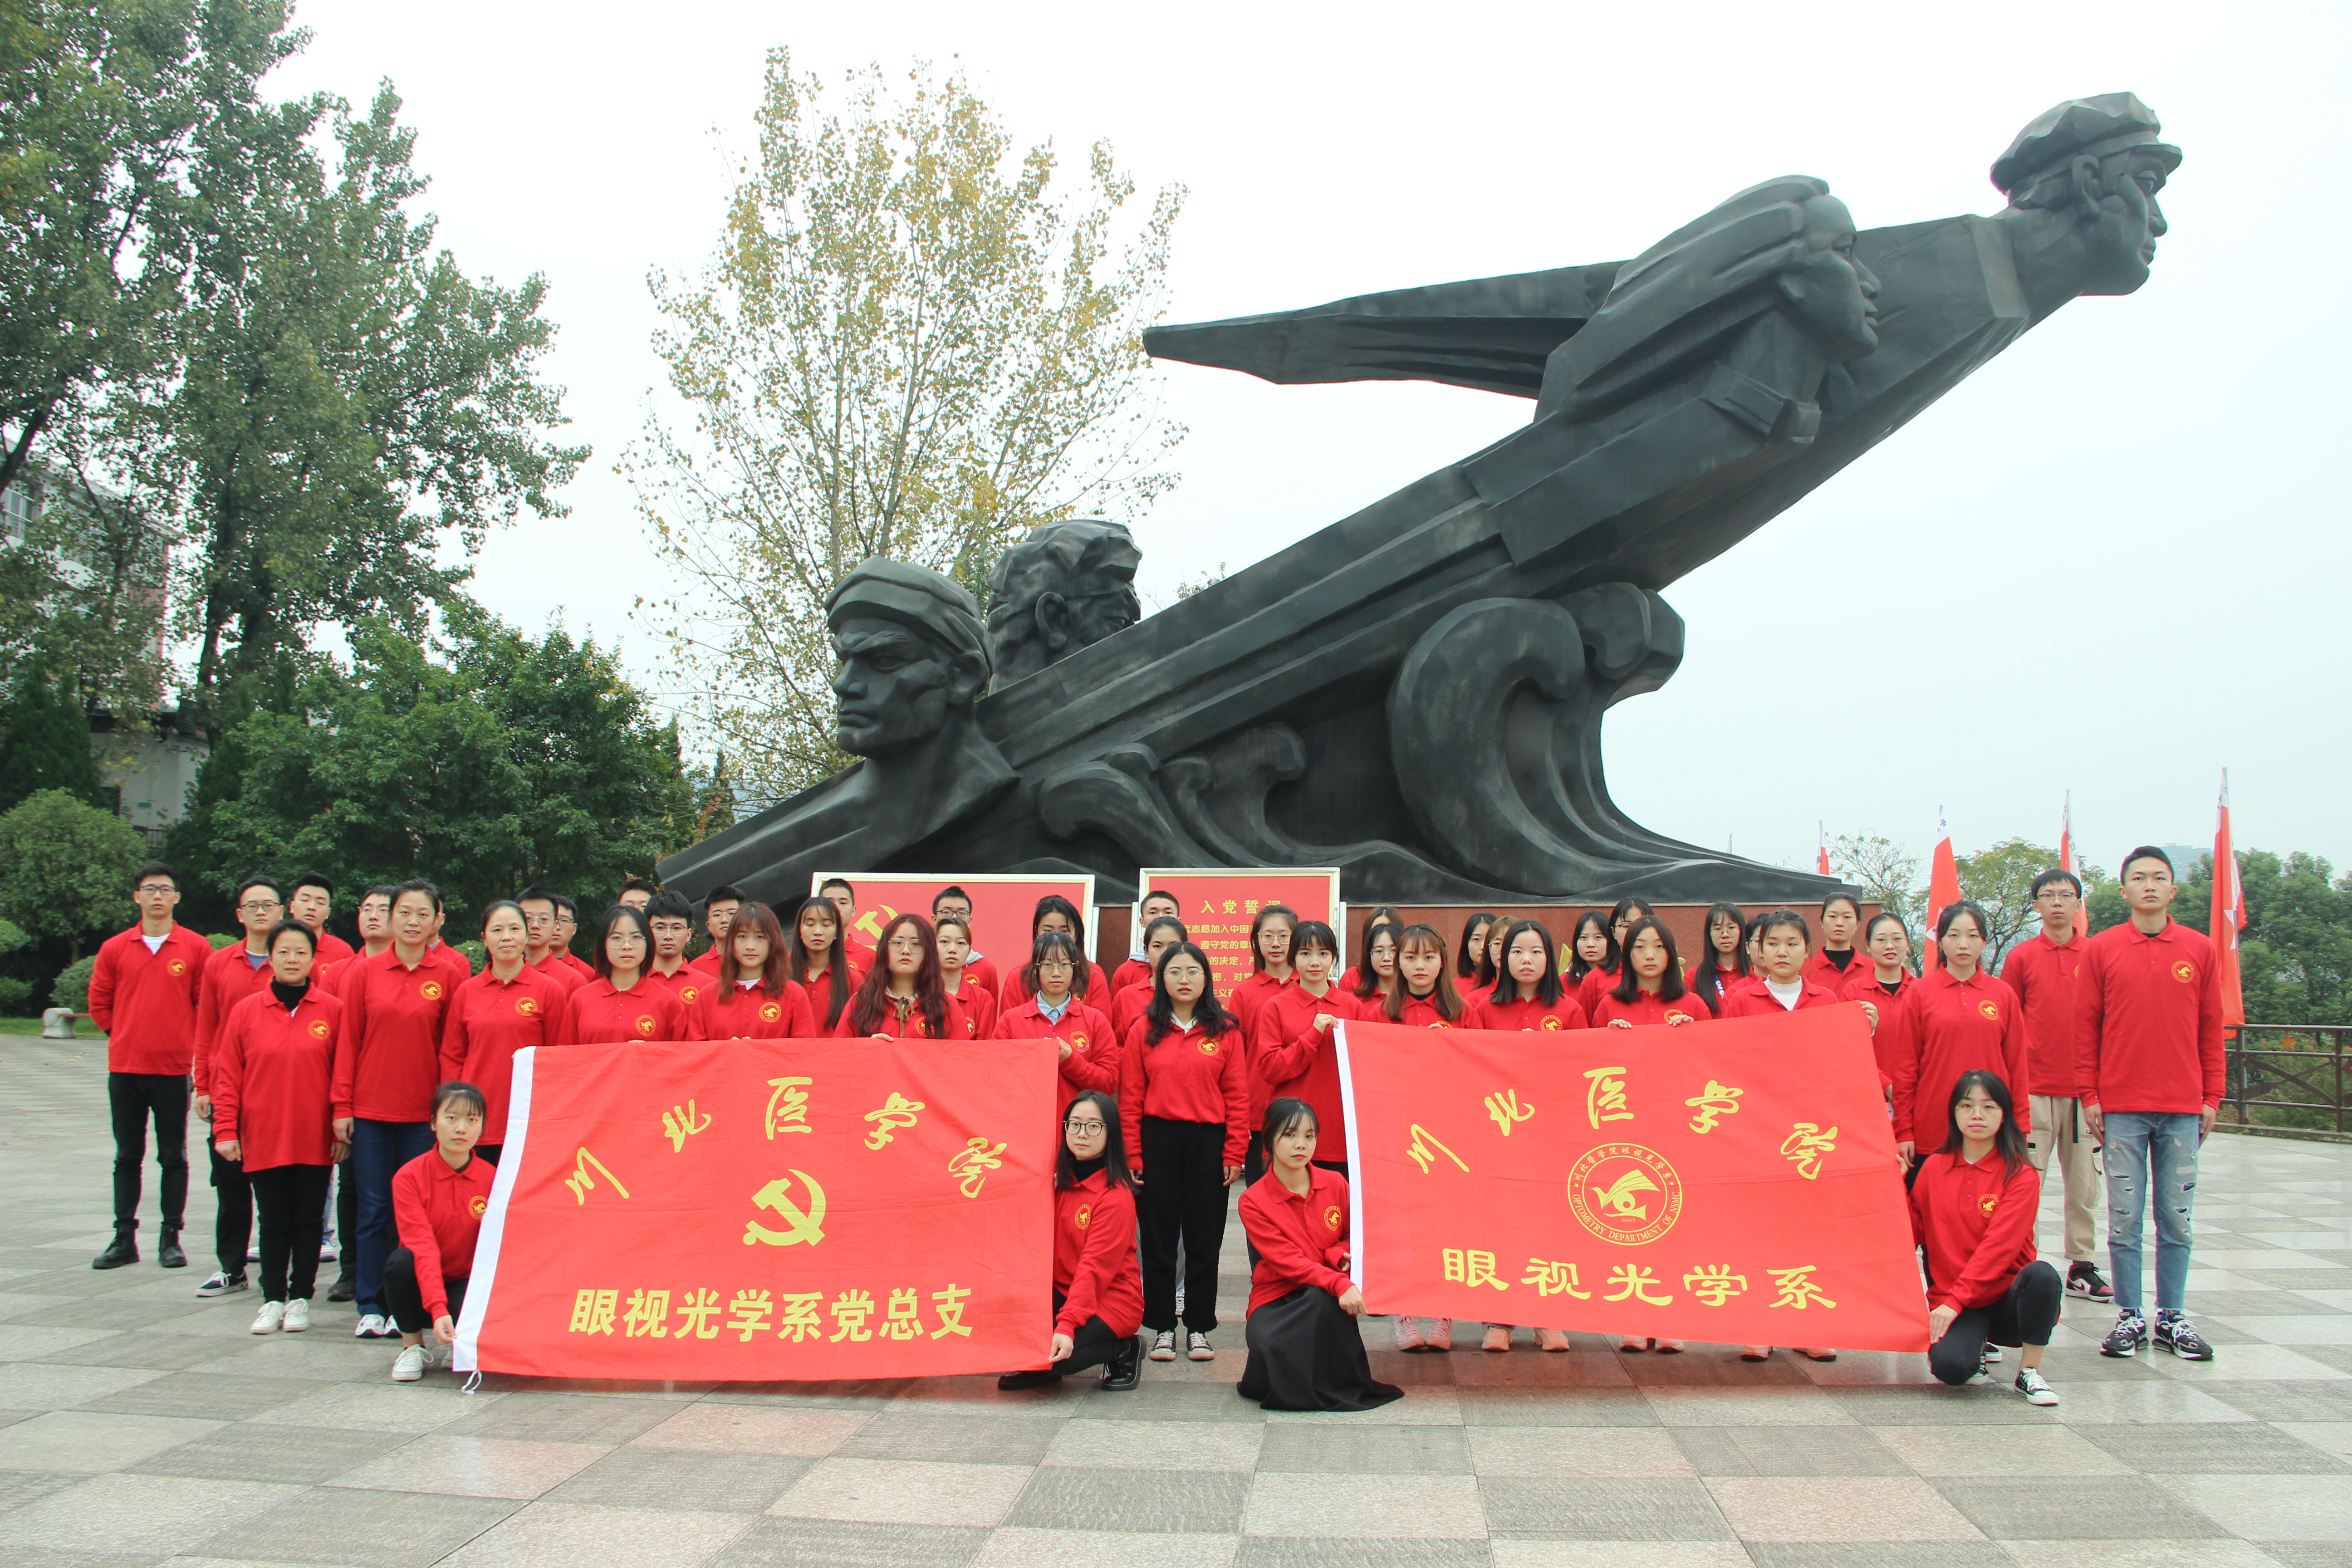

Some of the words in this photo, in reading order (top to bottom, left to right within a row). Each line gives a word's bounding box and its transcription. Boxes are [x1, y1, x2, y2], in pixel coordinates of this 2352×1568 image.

[1184, 924, 1253, 934] 我志愿加入中国
[1572, 1194, 1606, 1234] OPTOMETRY
[1608, 1224, 1662, 1242] DEPARTMENT
[1662, 1215, 1673, 1225] OF
[1669, 1191, 1680, 1213] NSMC
[1443, 1249, 1837, 1309] 眼视光学系
[569, 1284, 973, 1343] 眼视光学系党总支
